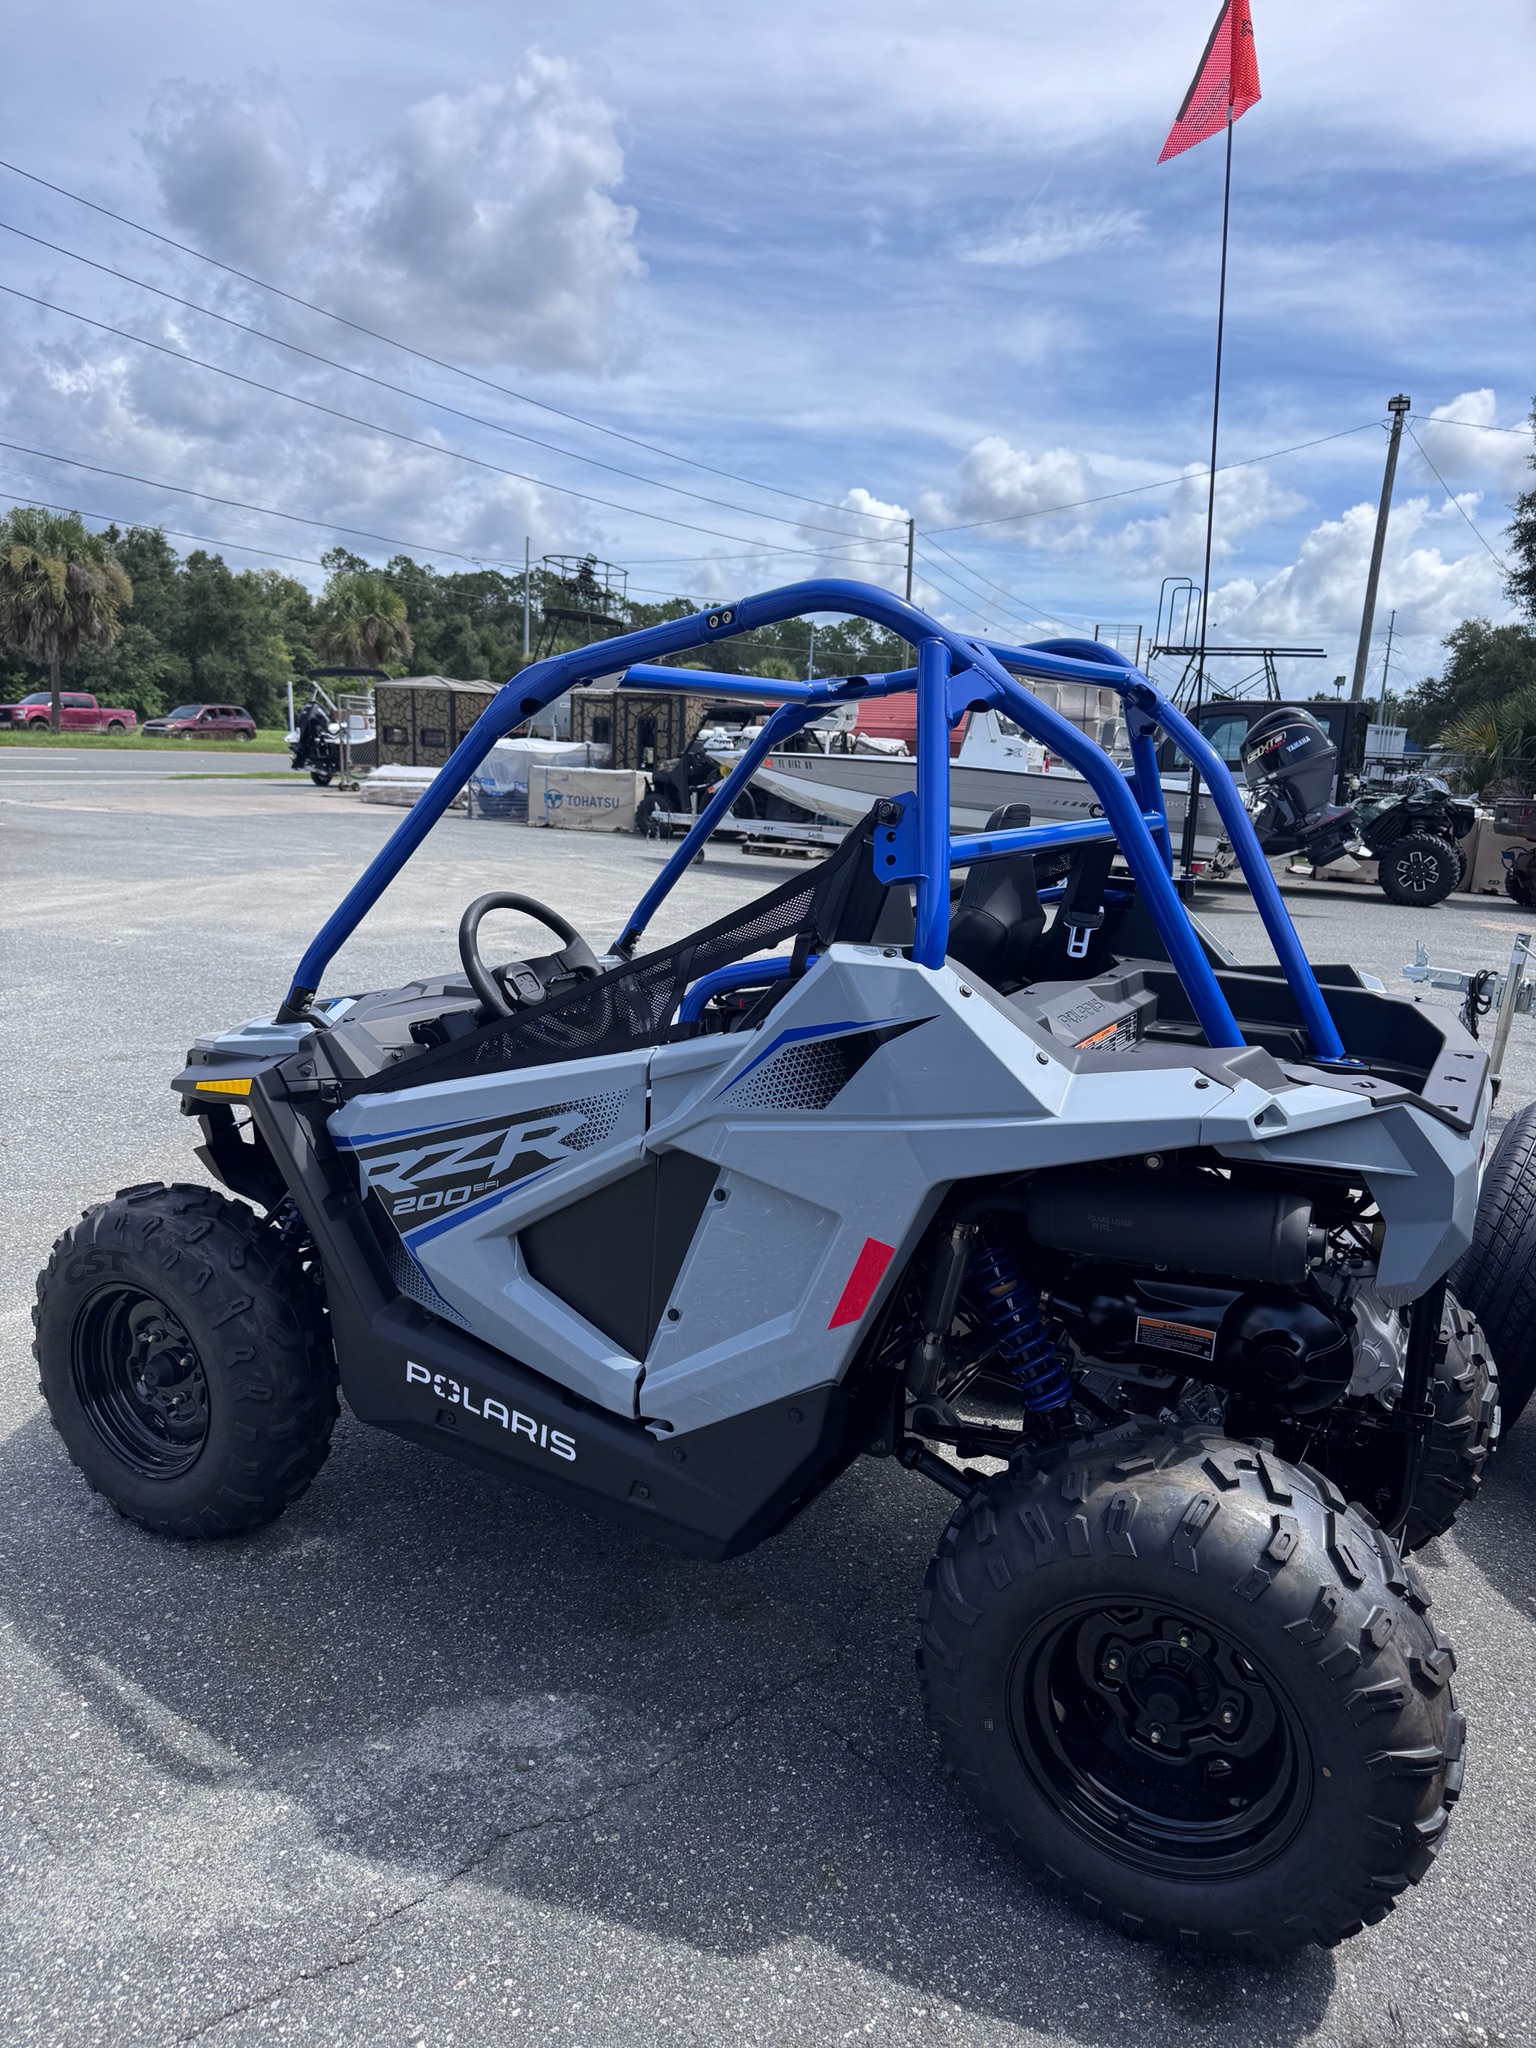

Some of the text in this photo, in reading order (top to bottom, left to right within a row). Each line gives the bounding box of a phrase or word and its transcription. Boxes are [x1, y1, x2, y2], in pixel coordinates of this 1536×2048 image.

[1286, 735, 1311, 752] YAMAHA
[566, 794, 620, 809] TOHATSU
[1057, 998, 1106, 1028] POLARIS
[359, 1111, 589, 1201] RZR
[392, 1180, 499, 1216] 200 EFI
[65, 1248, 129, 1286] CST
[406, 1360, 577, 1462] POLARIS
